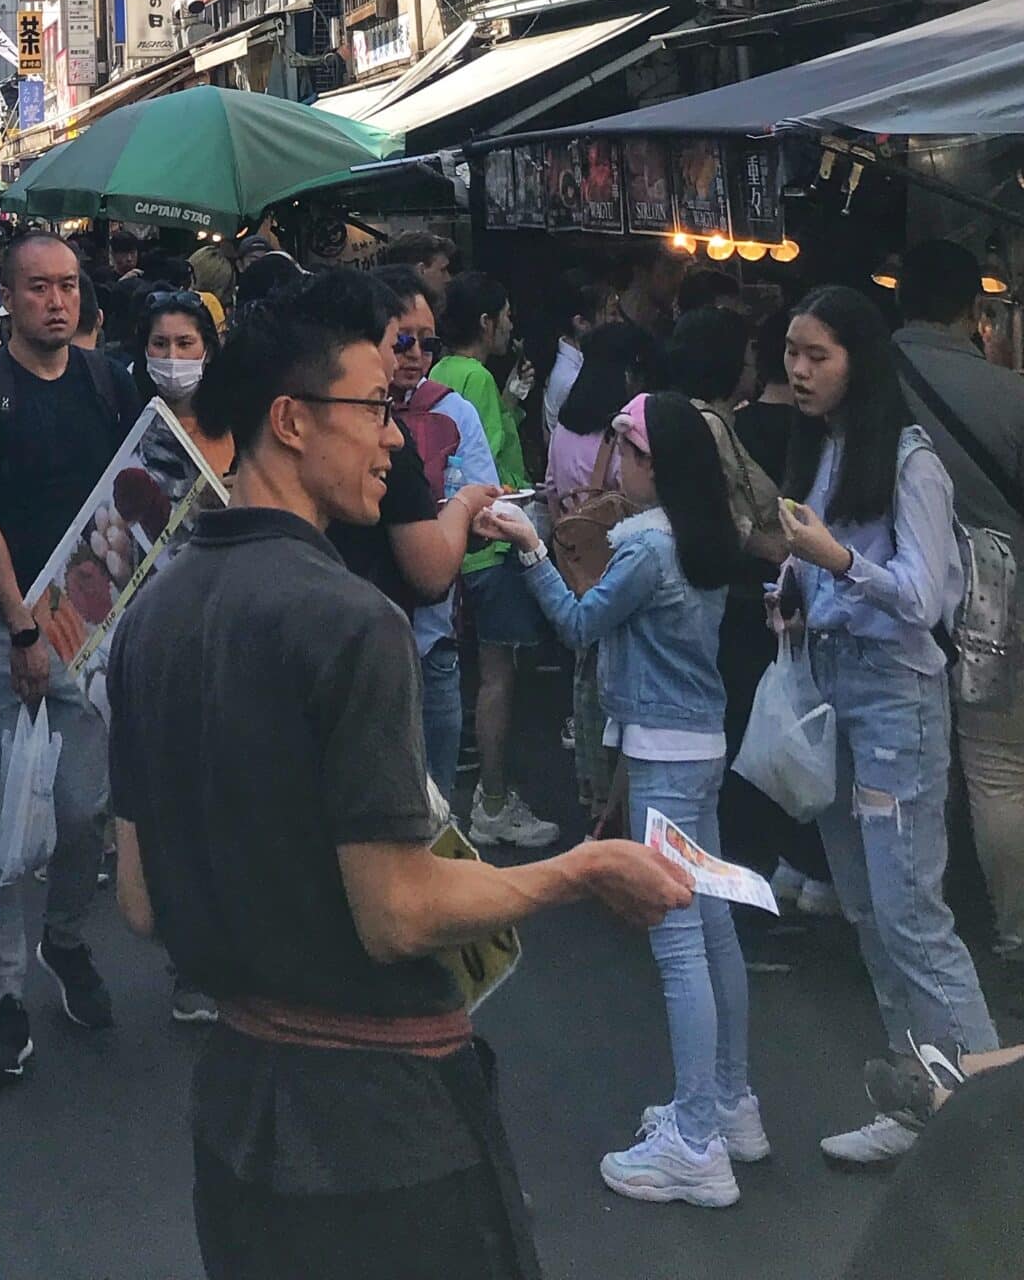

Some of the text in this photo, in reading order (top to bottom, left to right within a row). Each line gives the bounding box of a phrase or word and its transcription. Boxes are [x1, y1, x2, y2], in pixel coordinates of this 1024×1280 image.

[19, 16, 40, 55] 茶
[135, 202, 211, 226] CAPTAIN STAG
